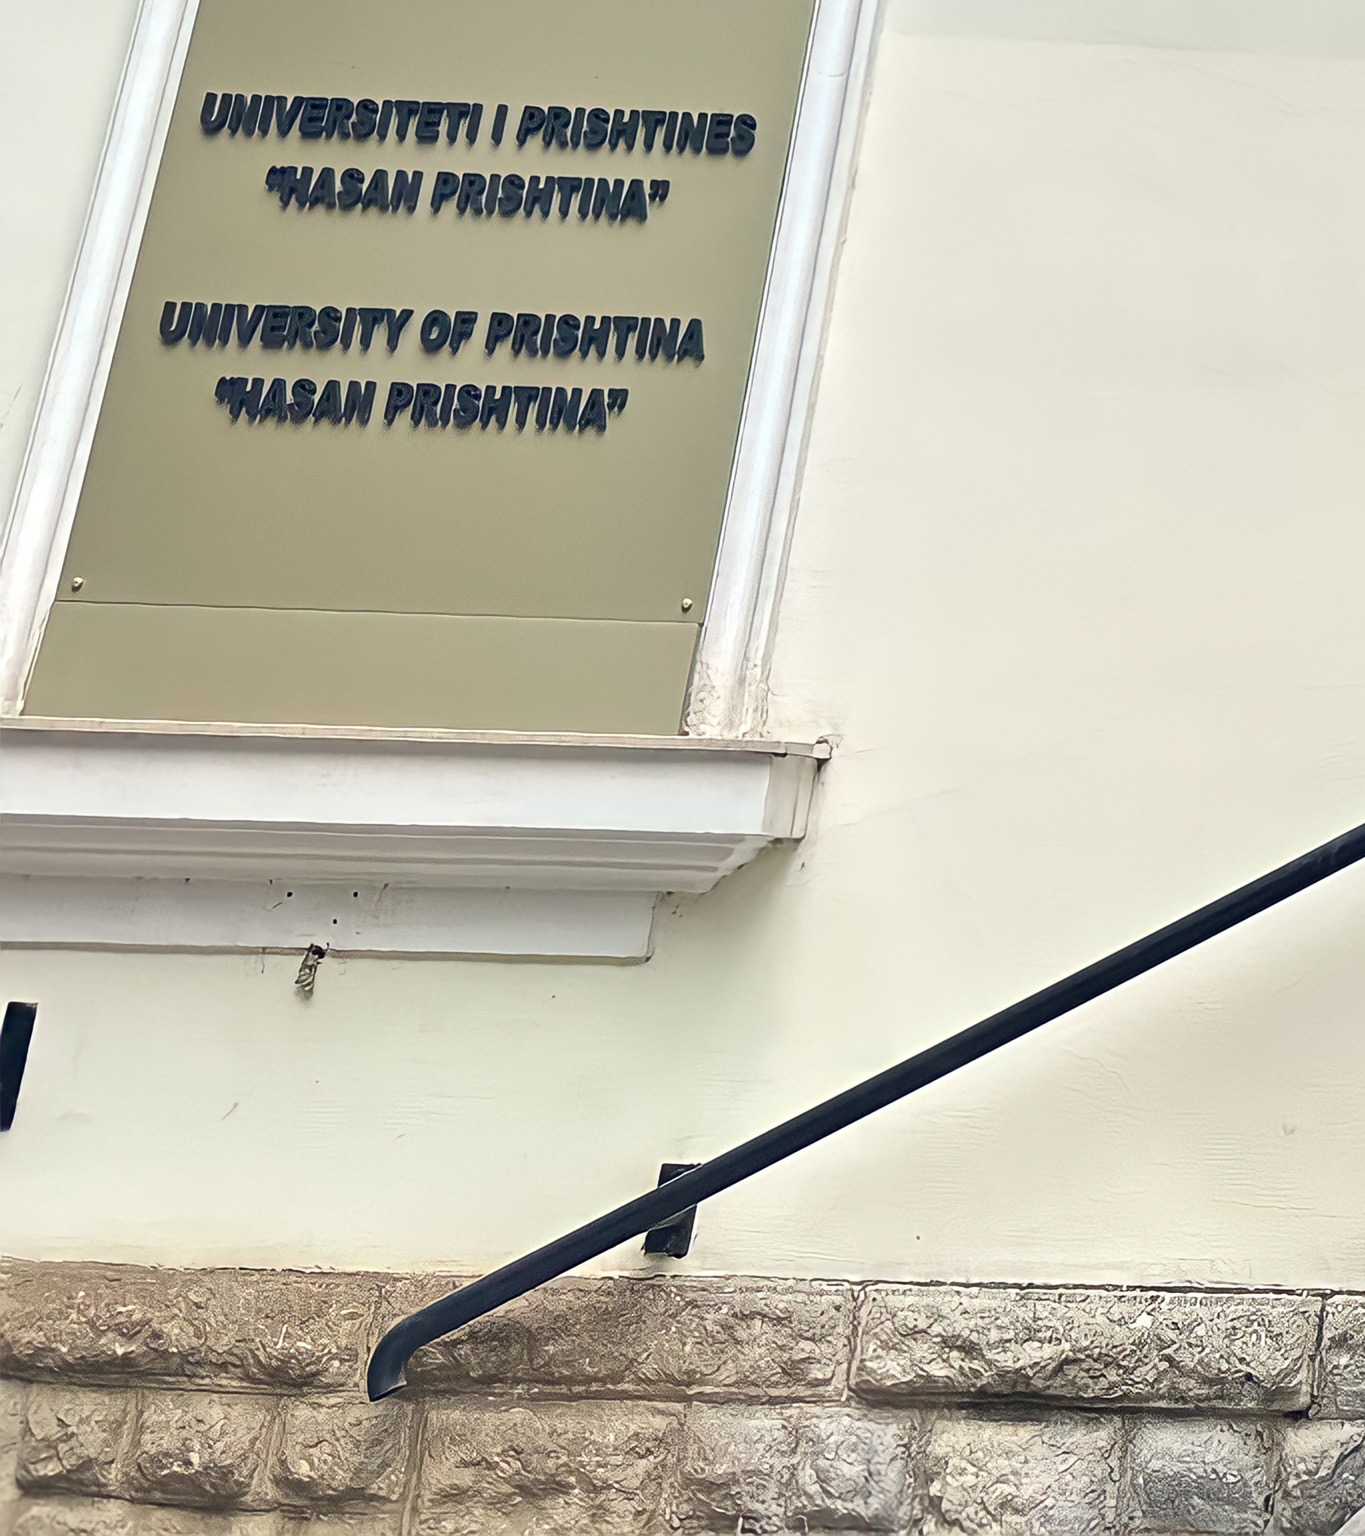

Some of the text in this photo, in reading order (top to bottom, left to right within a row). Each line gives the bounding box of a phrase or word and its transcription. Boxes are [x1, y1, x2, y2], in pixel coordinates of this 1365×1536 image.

[200, 92, 757, 156] UNIVERSITETI I PRISHTINES
[158, 301, 705, 363] UNIVERSITY OF PRISHTINA
